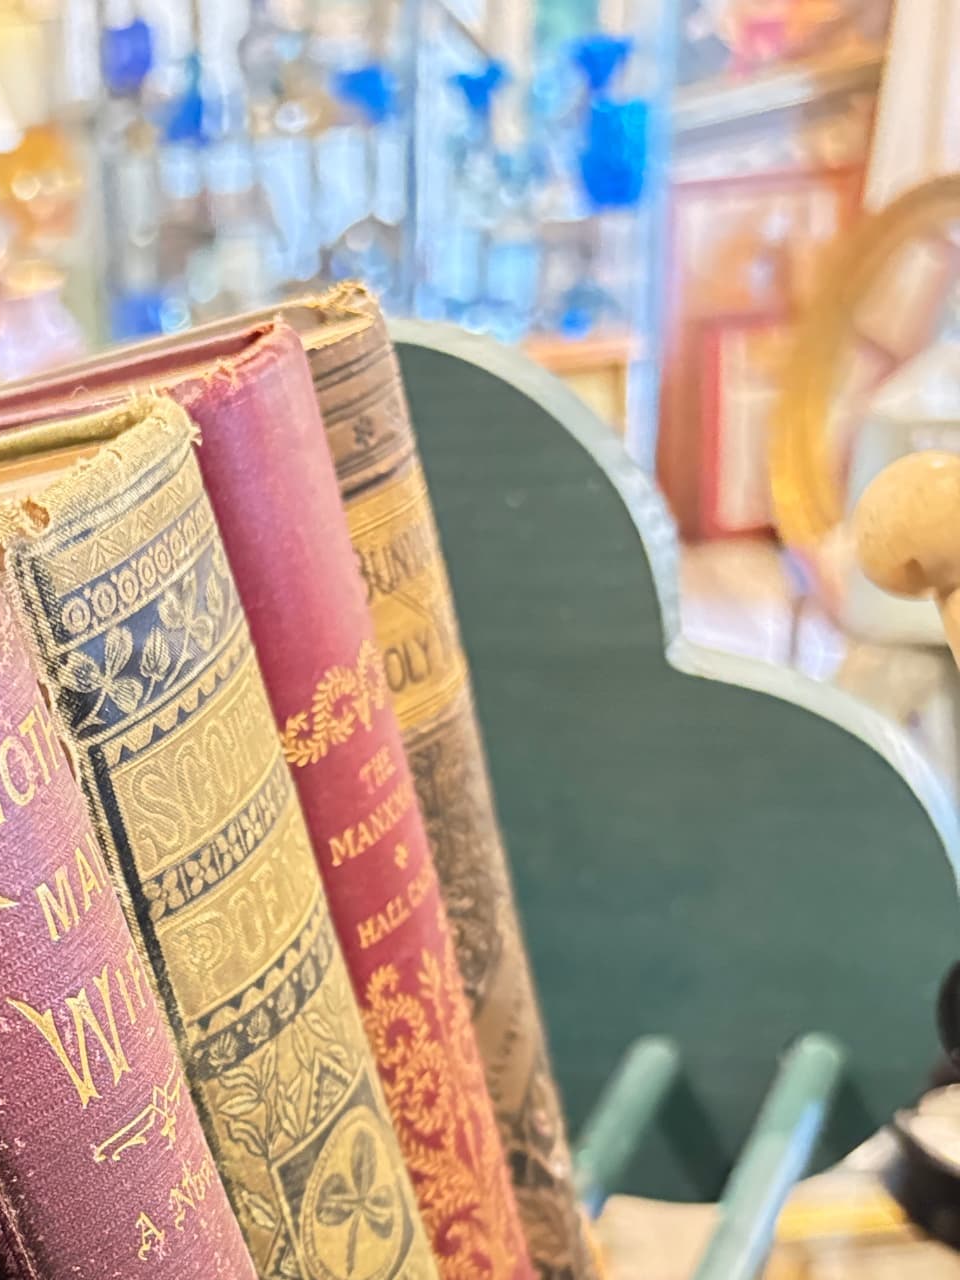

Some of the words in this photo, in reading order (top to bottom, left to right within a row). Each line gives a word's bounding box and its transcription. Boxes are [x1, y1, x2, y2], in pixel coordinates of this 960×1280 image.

[359, 746, 398, 794] THE
[356, 896, 412, 949] HALL
[135, 1210, 166, 1261] A
